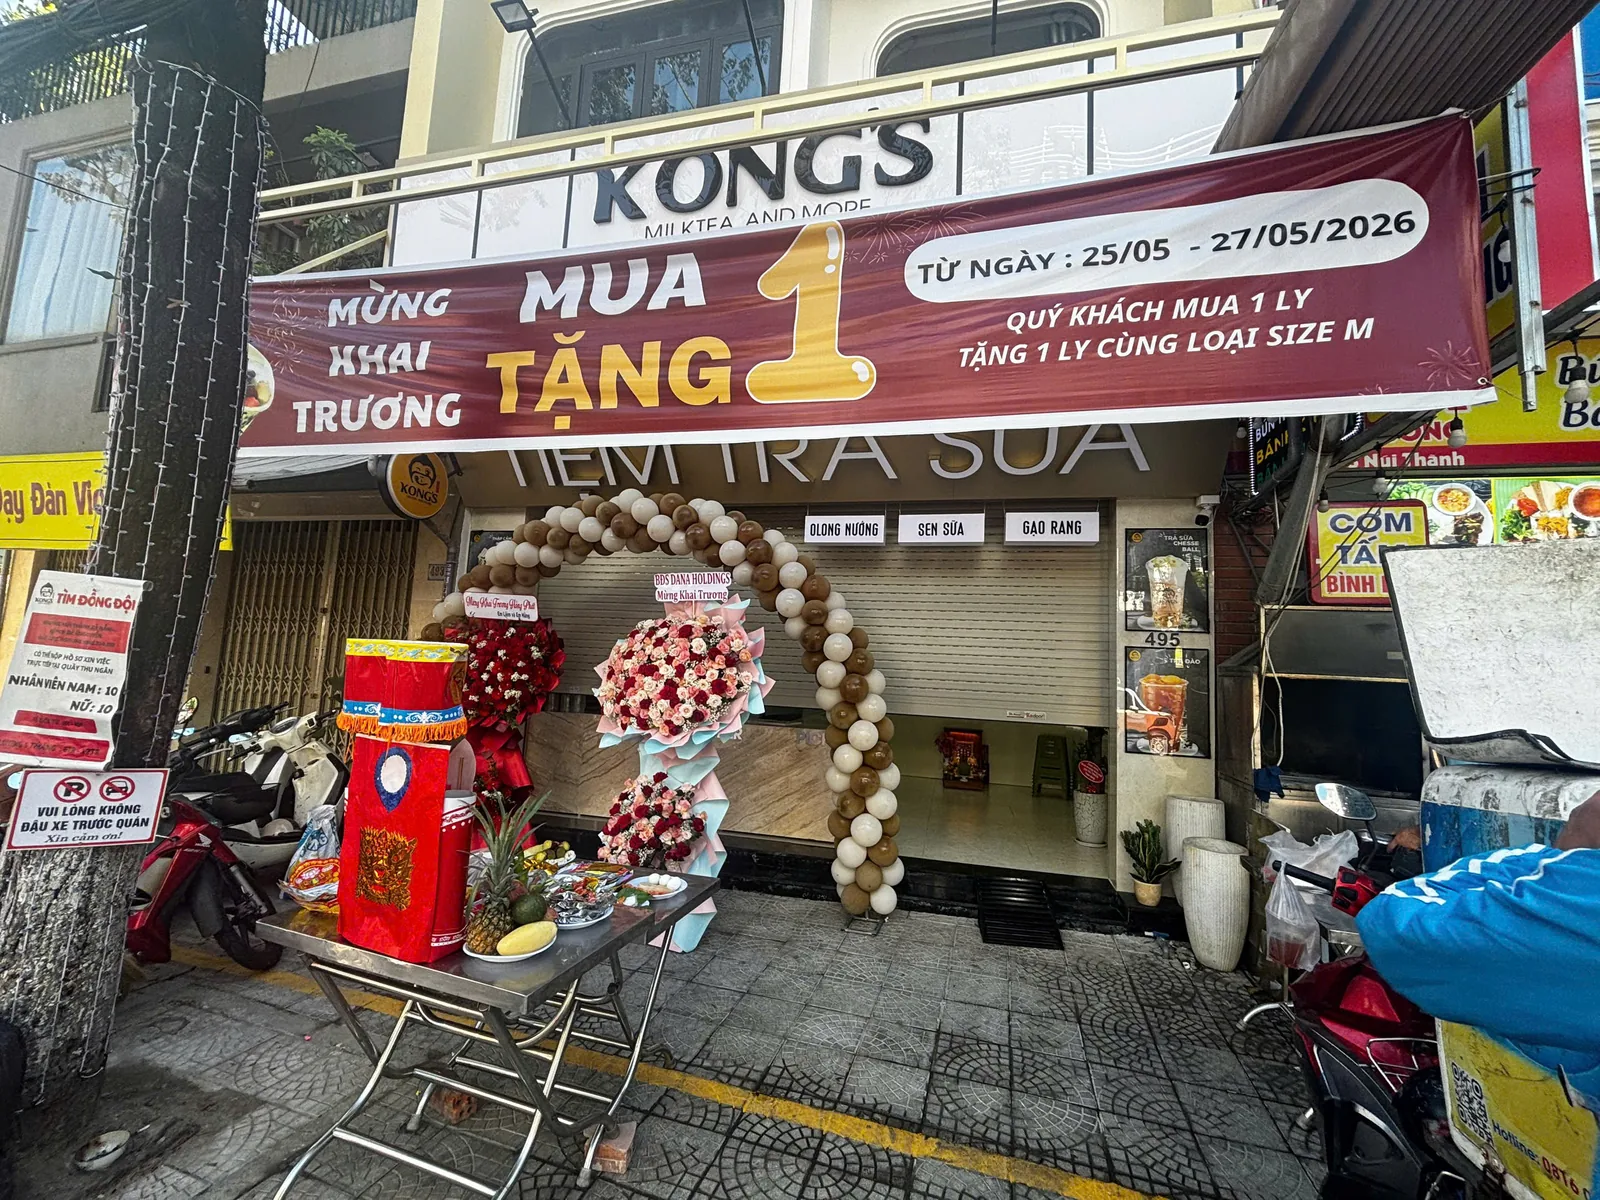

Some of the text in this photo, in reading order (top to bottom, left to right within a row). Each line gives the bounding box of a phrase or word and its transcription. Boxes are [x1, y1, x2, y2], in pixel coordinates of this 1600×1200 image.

[747, 207, 795, 228] AND
[918, 258, 962, 286] TỪ
[970, 250, 1056, 280] NGÀY
[1082, 238, 1171, 268] 25/05
[1211, 210, 1417, 254] 27/05/2026
[520, 253, 706, 323] MUA
[328, 280, 451, 327] MỪNG
[745, 220, 877, 404] 1
[1006, 287, 1315, 334] QUÝ KHÁCH MUA 1 LY
[959, 317, 1375, 373] TẶNG 1 LY CÙNG LOẠI SIZE M
[329, 341, 430, 377] KHAI
[486, 331, 732, 430] TẶNG
[293, 393, 462, 433] TRƯƠNG
[1364, 453, 1397, 468] Núi
[31, 482, 67, 516] Đàn
[400, 481, 438, 504] KONG'S
[810, 521, 879, 537] OLONG NƯỚNG
[918, 520, 964, 537] SEN SỮA
[1023, 520, 1082, 537] GẠO RANG
[1330, 509, 1412, 533] CƠM
[1336, 536, 1388, 565] TẤ
[655, 573, 731, 585] BĐS DANA HOLDINGS
[1327, 572, 1375, 593] BÌNH
[57, 589, 136, 614] TÌM ĐỒNG ĐỘI
[657, 589, 727, 601] Mừng Khai Trương
[1145, 632, 1180, 647] 495
[80, 664, 94, 673] THU
[84, 655, 95, 664] XIN
[8, 673, 46, 687] NHÂN
[45, 676, 66, 691] VIÊN
[66, 682, 96, 695] NAM
[104, 686, 118, 697] 10
[97, 704, 113, 714] 10
[37, 803, 141, 817] VUI LÒNG KHÔNG
[21, 817, 150, 834] ĐẬU XE TRƯỚC QUÁN
[45, 834, 69, 843] Xin
[102, 832, 123, 841] ơn!
[1492, 1119, 1541, 1166] Hotline:
